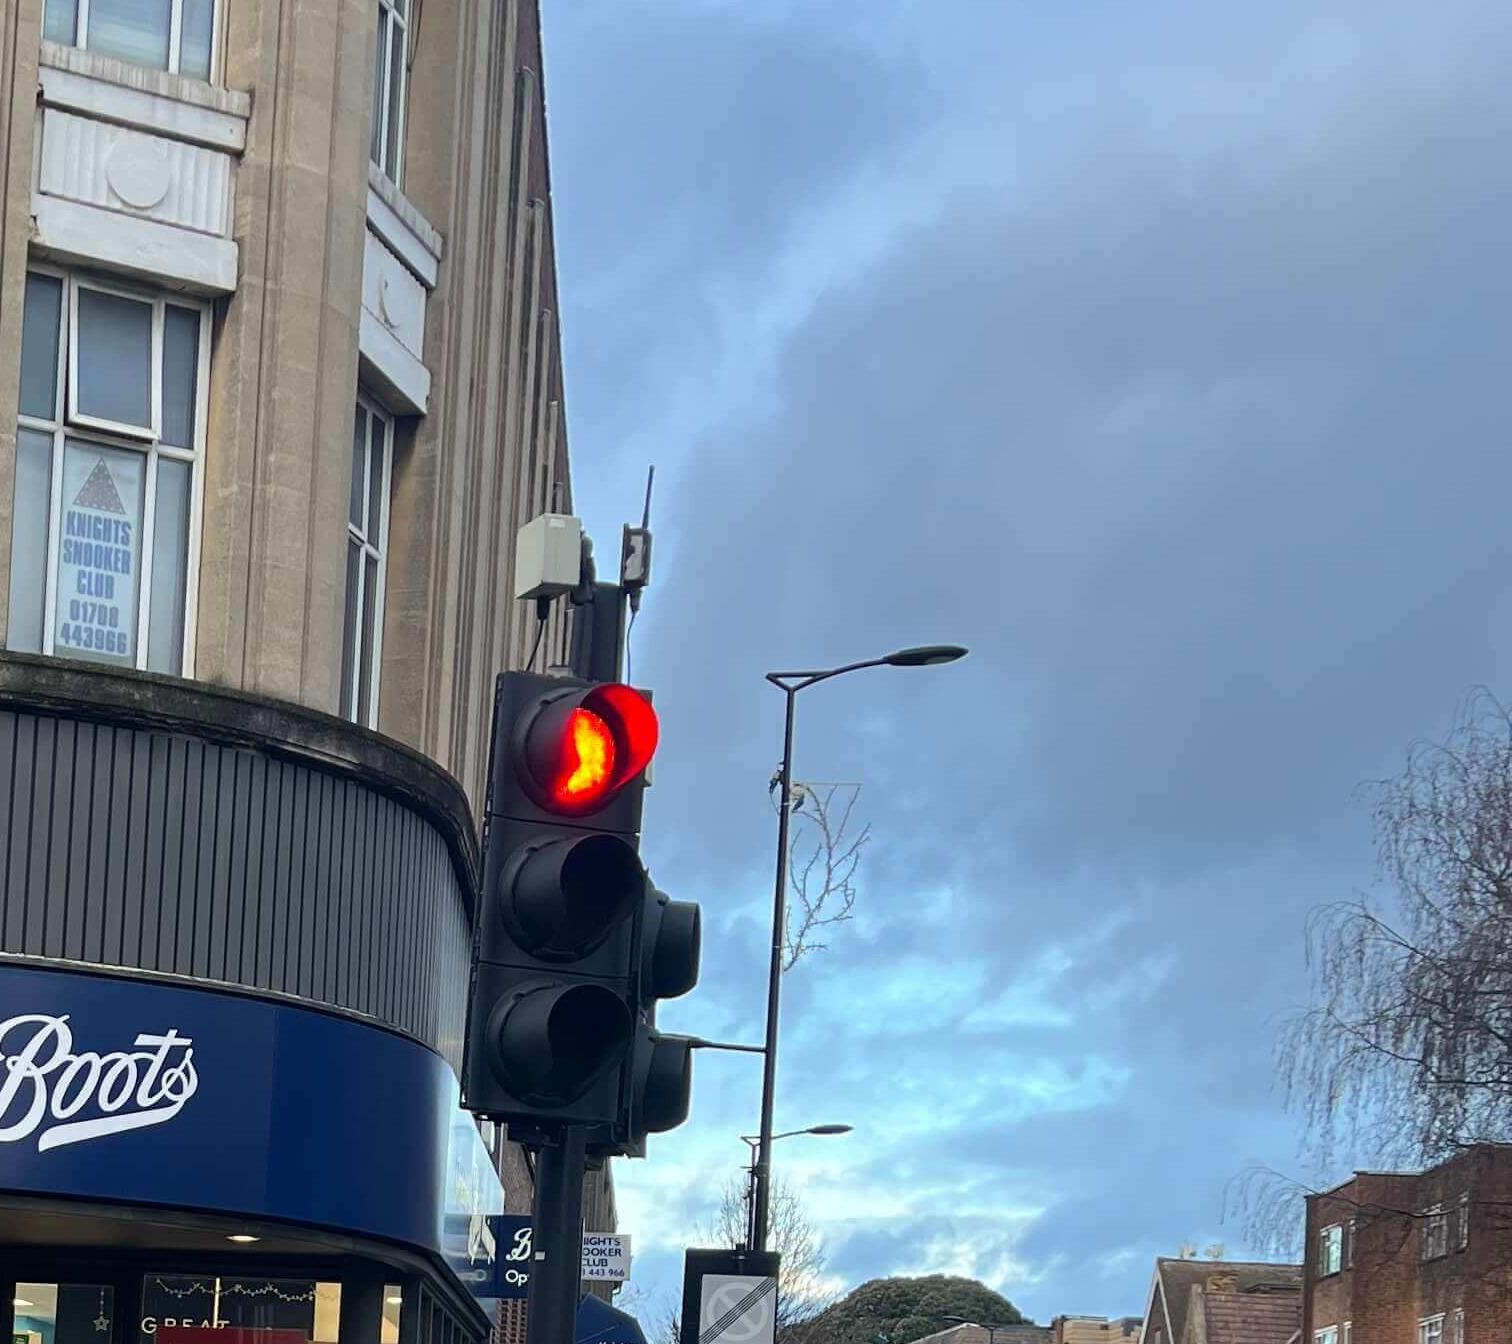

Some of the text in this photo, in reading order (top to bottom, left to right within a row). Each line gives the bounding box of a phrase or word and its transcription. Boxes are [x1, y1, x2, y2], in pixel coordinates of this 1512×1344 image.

[66, 510, 132, 546] KNIGHTS
[63, 538, 132, 575] SNOOKER
[77, 569, 115, 599] CLUB
[60, 622, 127, 654] 443966
[583, 1247, 622, 1257] OOKER
[588, 1268, 605, 1277] 443
